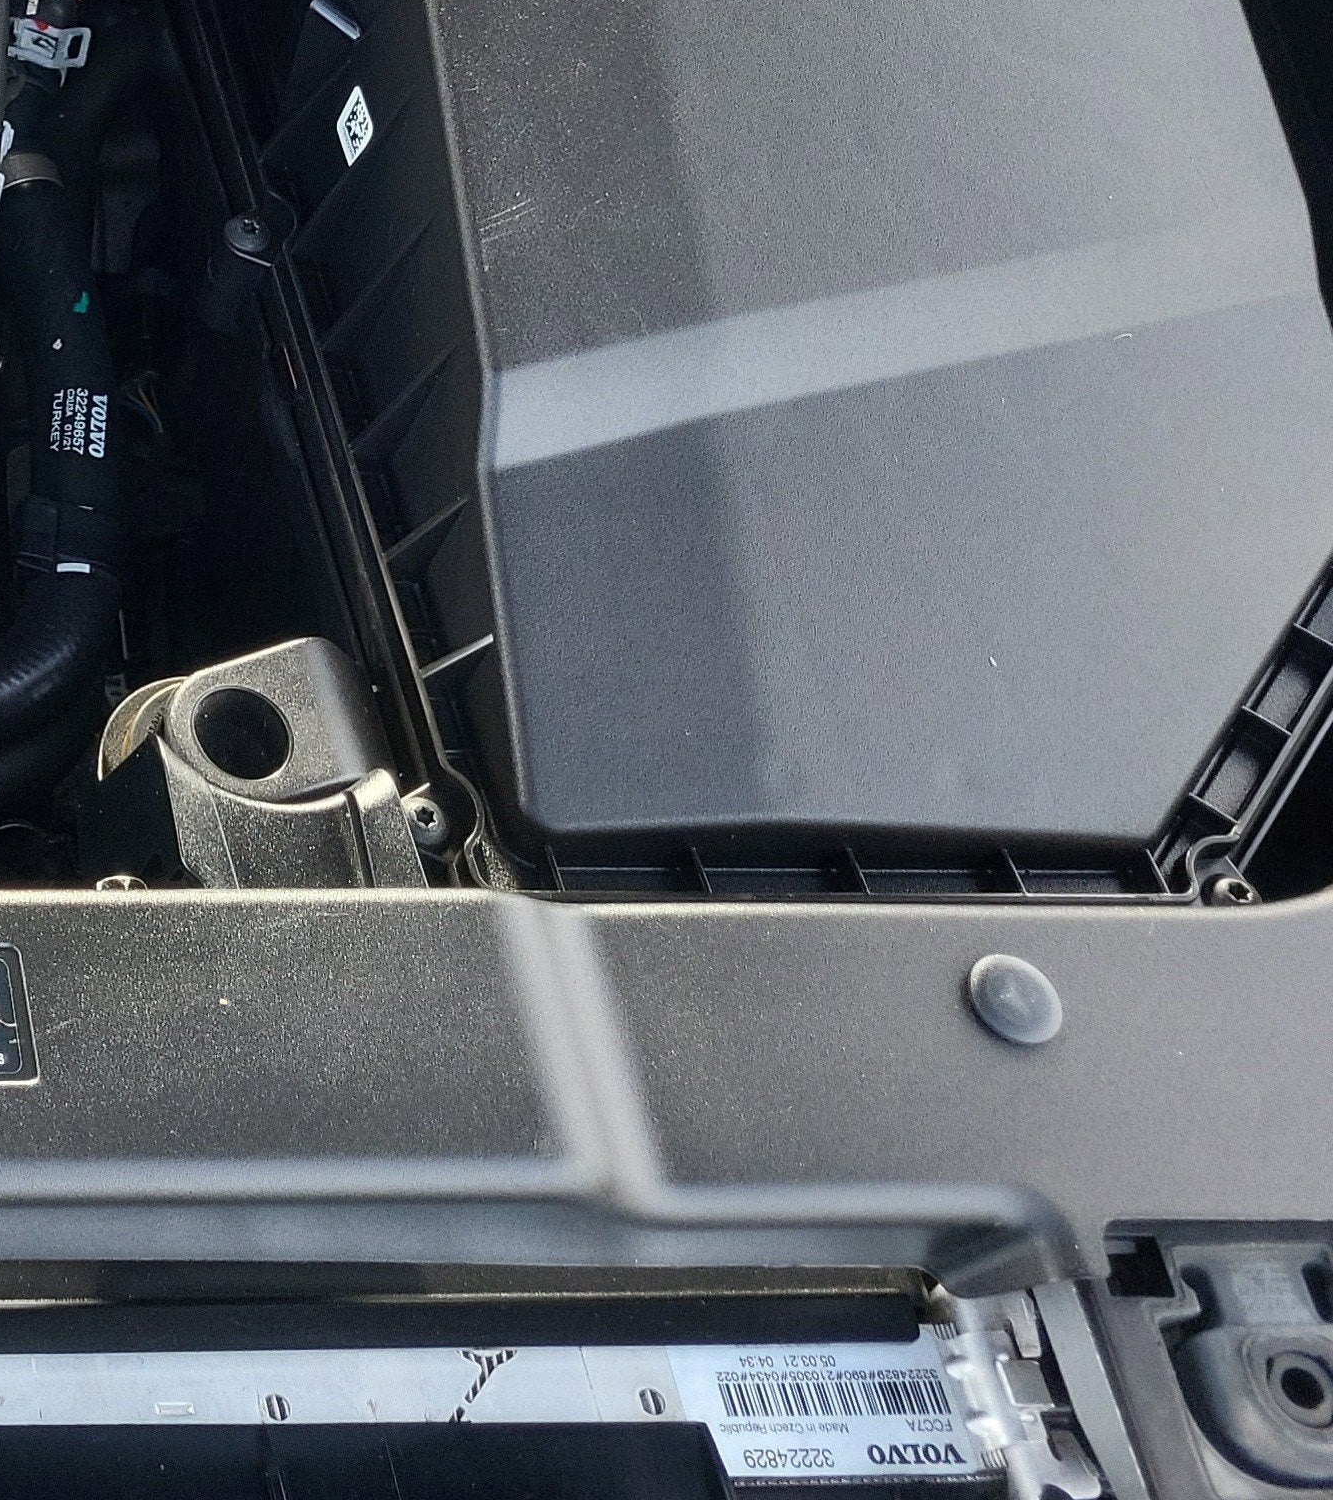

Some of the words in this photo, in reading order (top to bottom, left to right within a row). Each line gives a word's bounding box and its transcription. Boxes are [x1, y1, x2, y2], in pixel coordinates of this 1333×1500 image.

[49, 389, 64, 452] TURKEY
[72, 387, 89, 455] 32249657
[88, 394, 108, 458] VOLVO
[62, 423, 73, 451] 01/21
[739, 1355, 774, 1368] 04:34
[783, 1354, 836, 1368] 05.03.21
[719, 1420, 768, 1435] Republic
[768, 1422, 804, 1434] Czech
[806, 1422, 818, 1434] in
[819, 1421, 850, 1435] Made
[743, 1448, 835, 1469] 32224829
[866, 1443, 968, 1465] VOLVO
